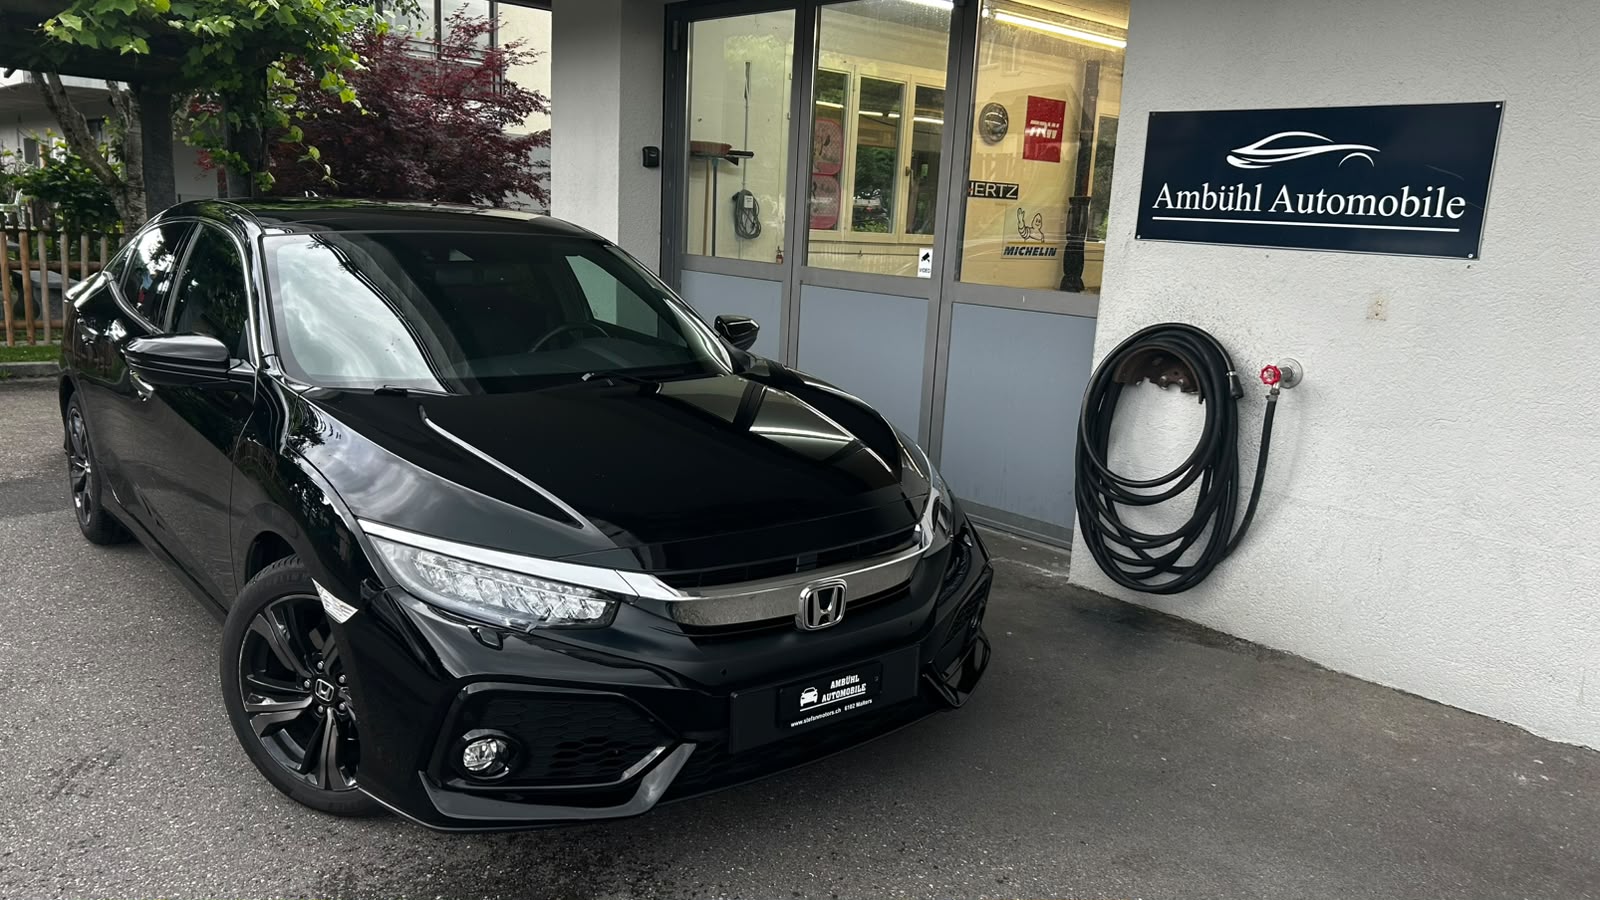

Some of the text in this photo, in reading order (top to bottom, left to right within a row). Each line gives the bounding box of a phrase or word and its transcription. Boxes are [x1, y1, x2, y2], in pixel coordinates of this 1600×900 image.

[1152, 182, 1466, 219] Ambühl Automobile
[1003, 246, 1057, 257] MICHELIN
[830, 675, 860, 689] AMBÜHL
[822, 683, 867, 702] AUTOMOBILE
